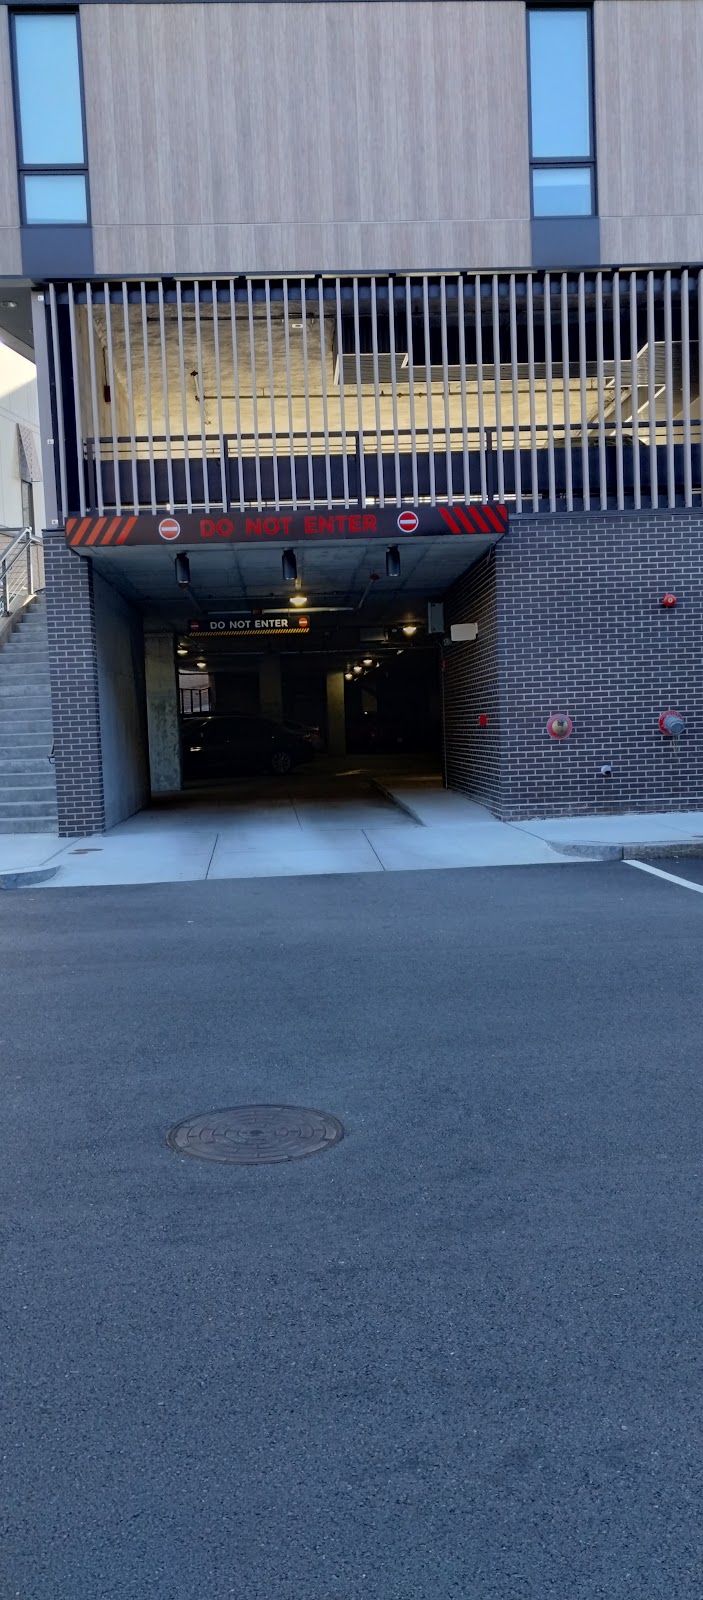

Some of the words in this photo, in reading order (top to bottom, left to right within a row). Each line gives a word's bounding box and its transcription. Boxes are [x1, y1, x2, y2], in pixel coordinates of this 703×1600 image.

[201, 519, 233, 537] DO
[246, 517, 292, 535] NOT
[304, 515, 377, 533] ENTER
[210, 621, 226, 629] DO
[230, 620, 251, 628] NOT
[254, 619, 288, 628] ENTER
